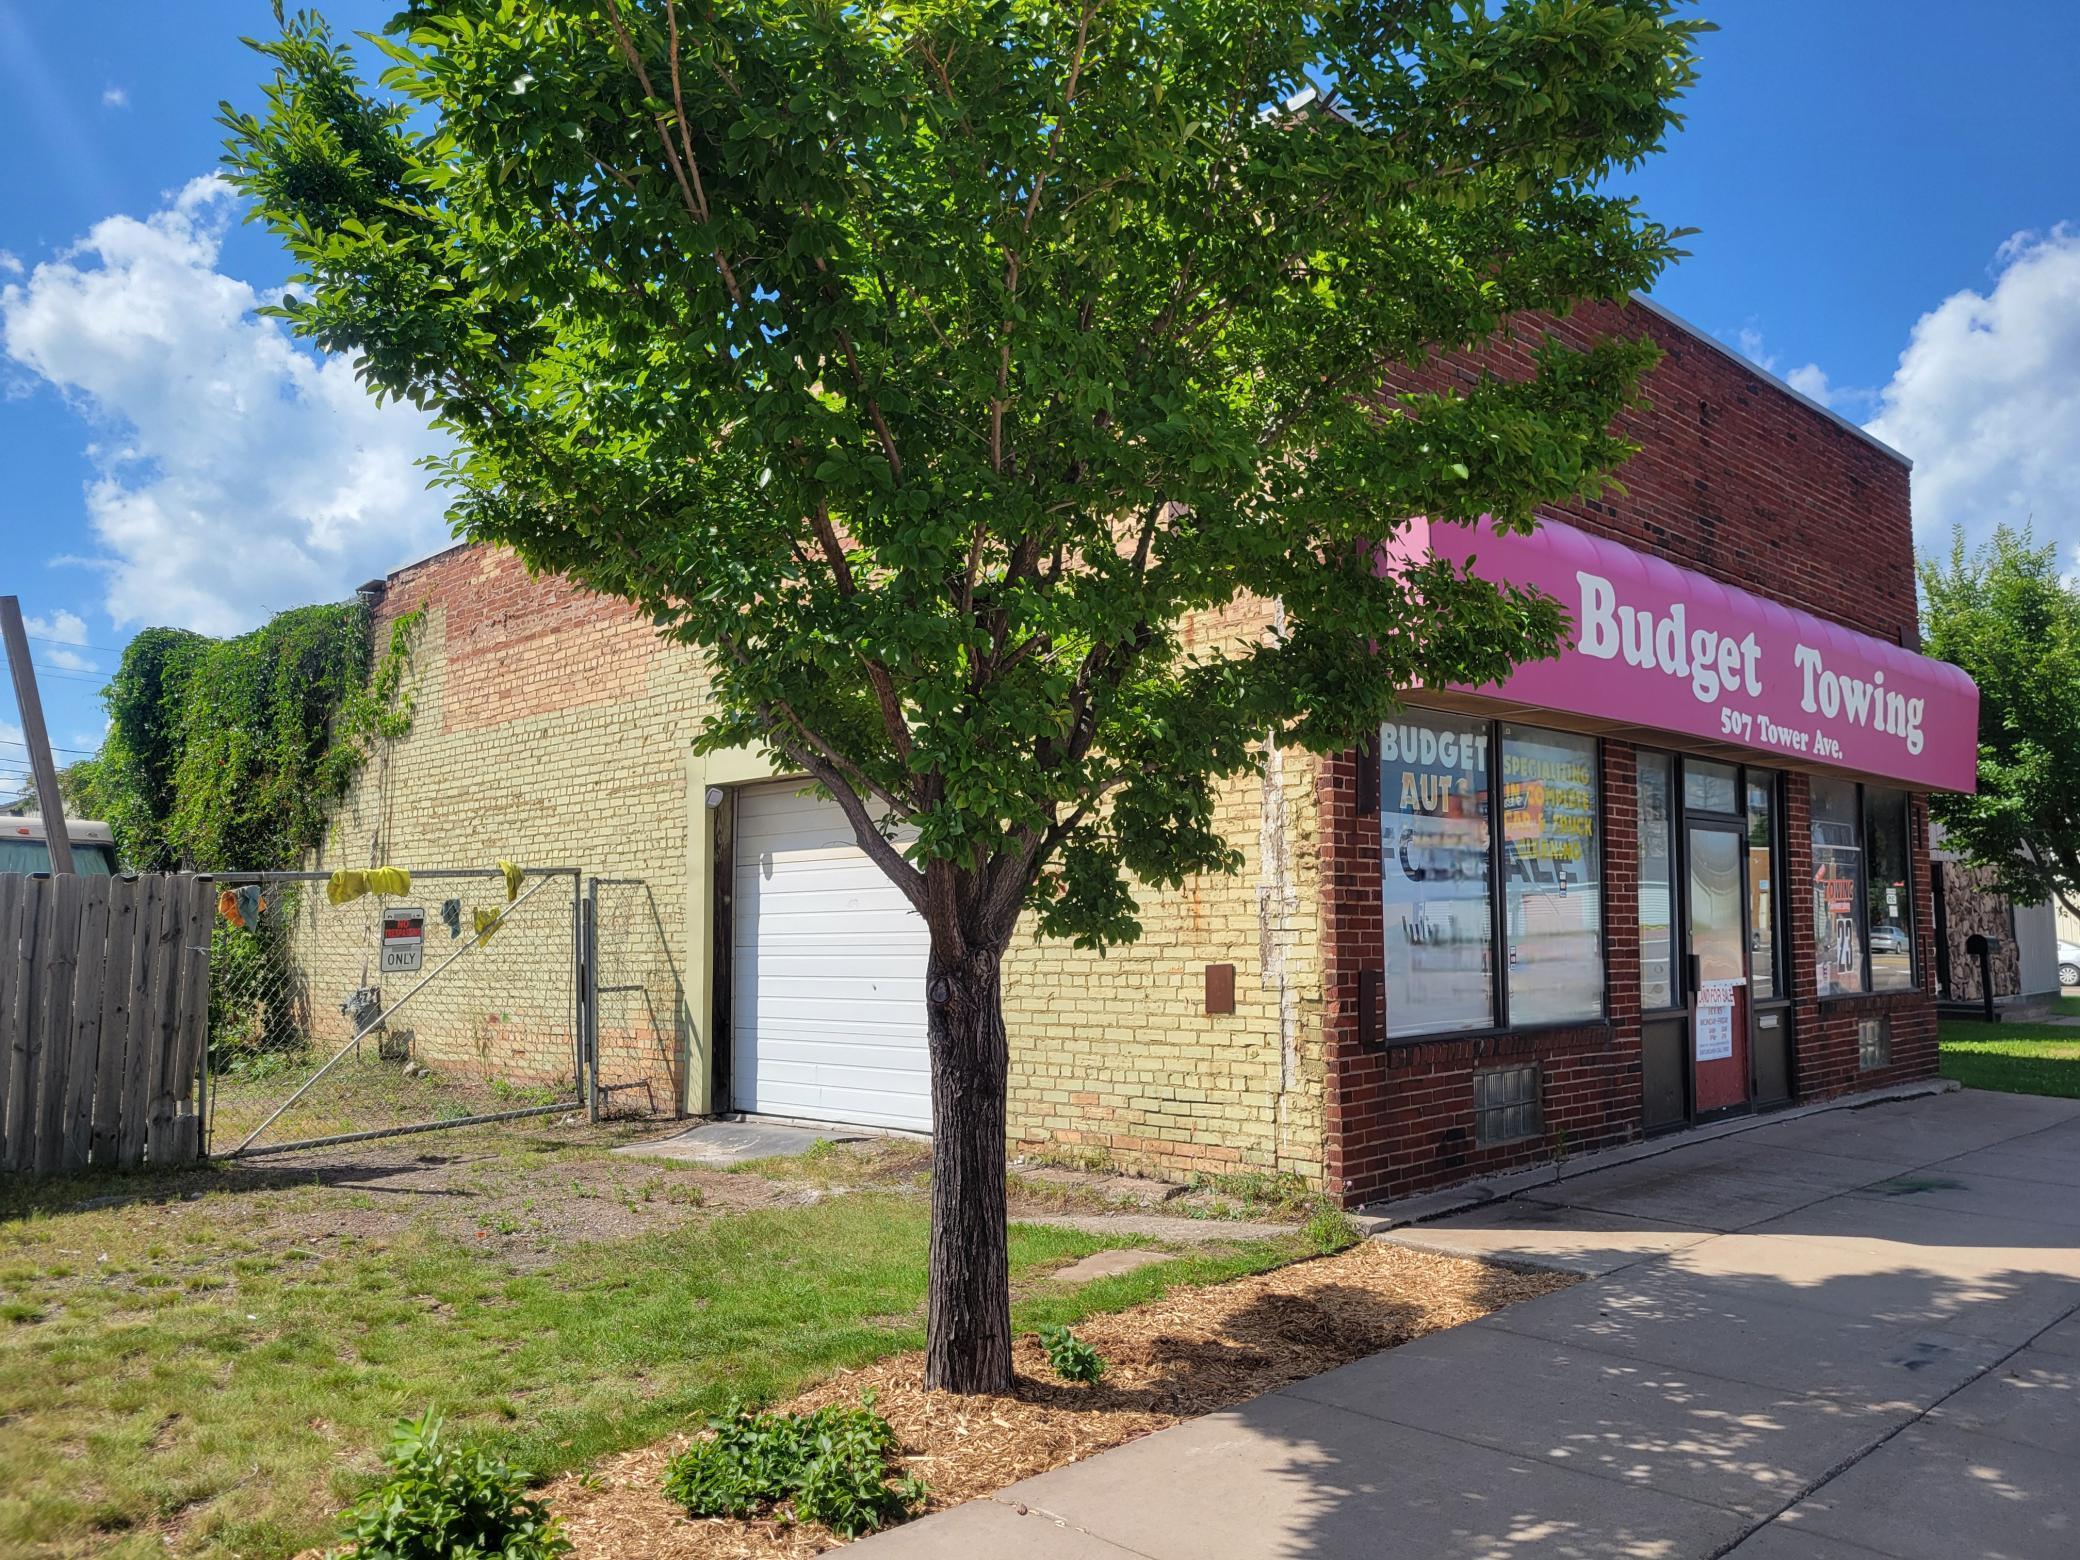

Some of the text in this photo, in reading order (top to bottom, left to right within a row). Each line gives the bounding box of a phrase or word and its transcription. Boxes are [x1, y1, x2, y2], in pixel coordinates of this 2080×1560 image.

[1576, 571, 1924, 755] Budget Towing
[1381, 722, 1488, 772] BUDGET
[1721, 707, 1843, 759] 507 Tower Ave.
[1400, 771, 1468, 813] AUT
[1824, 880, 1854, 900] TOWING
[397, 920, 408, 929] NO
[387, 953, 416, 966] ONLY
